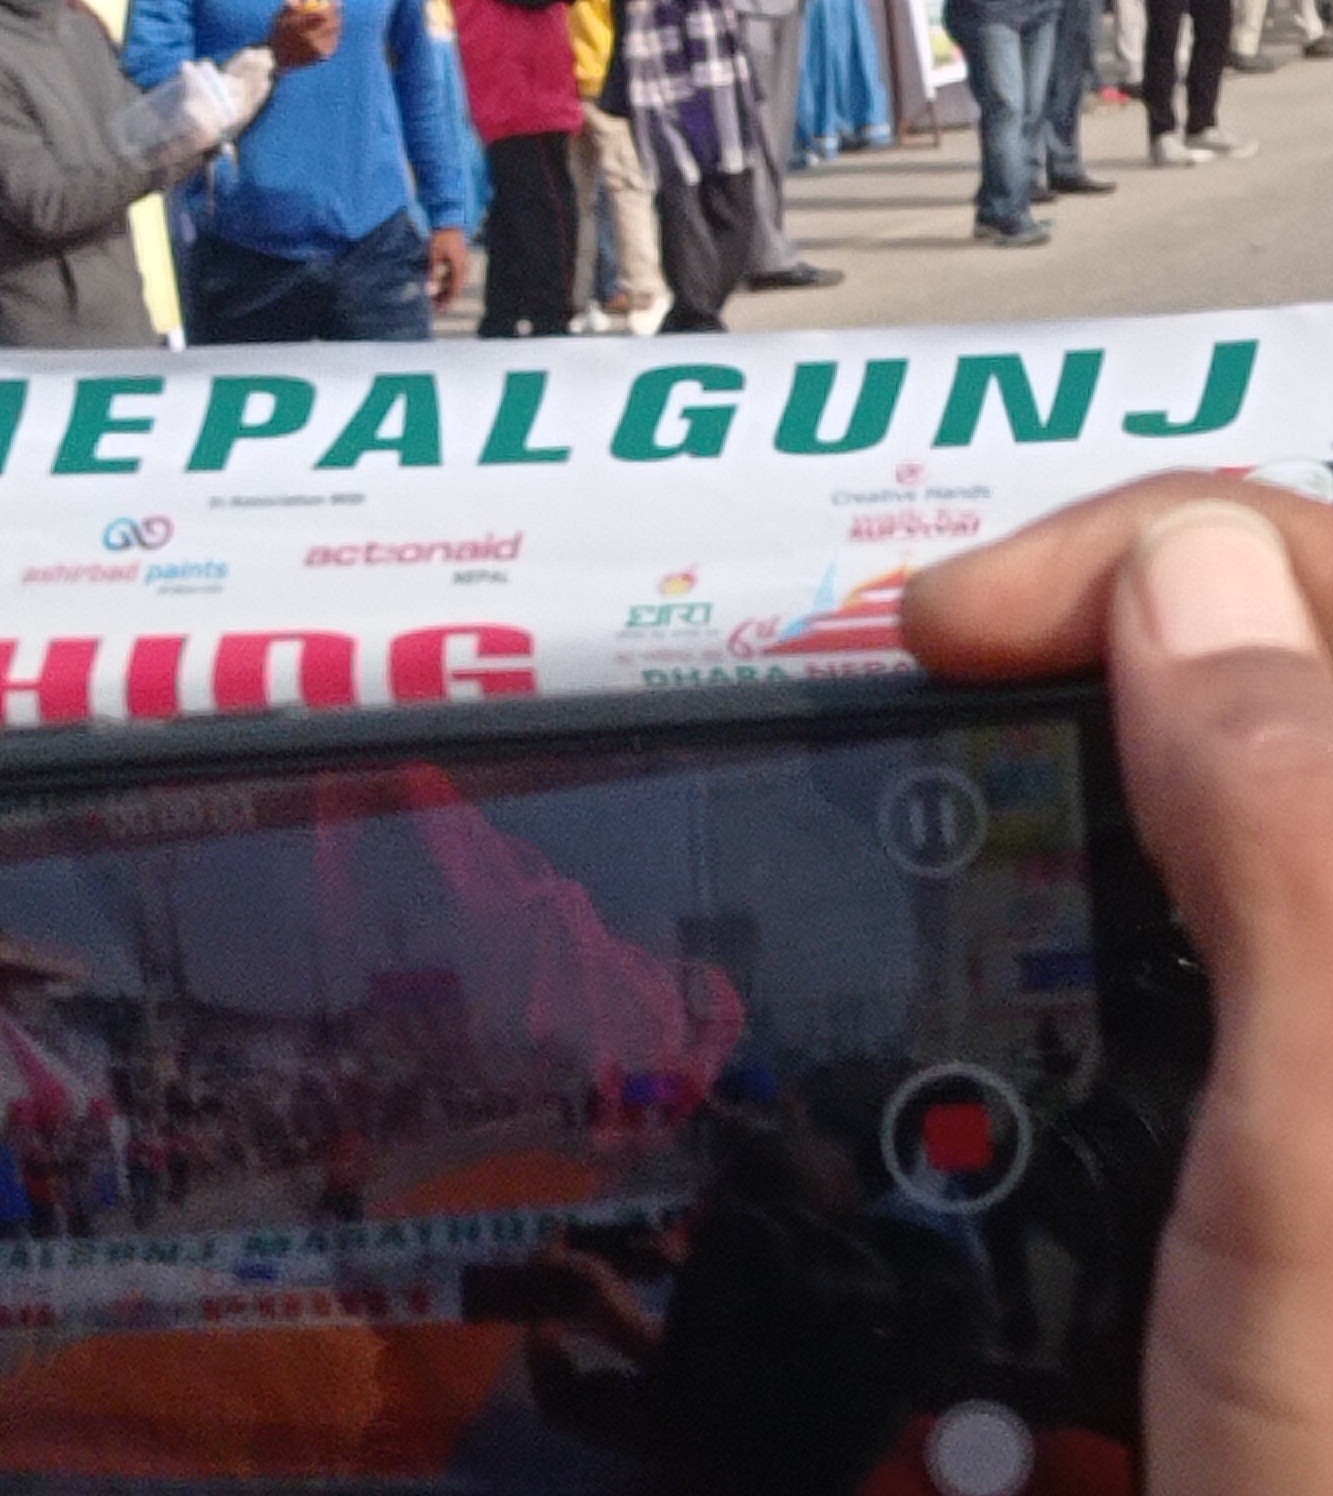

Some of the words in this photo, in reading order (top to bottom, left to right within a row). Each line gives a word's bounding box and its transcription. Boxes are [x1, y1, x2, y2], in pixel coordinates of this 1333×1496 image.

[303, 530, 524, 568] actionaid
[144, 559, 228, 586] paints
[453, 569, 511, 585] NEPAL
